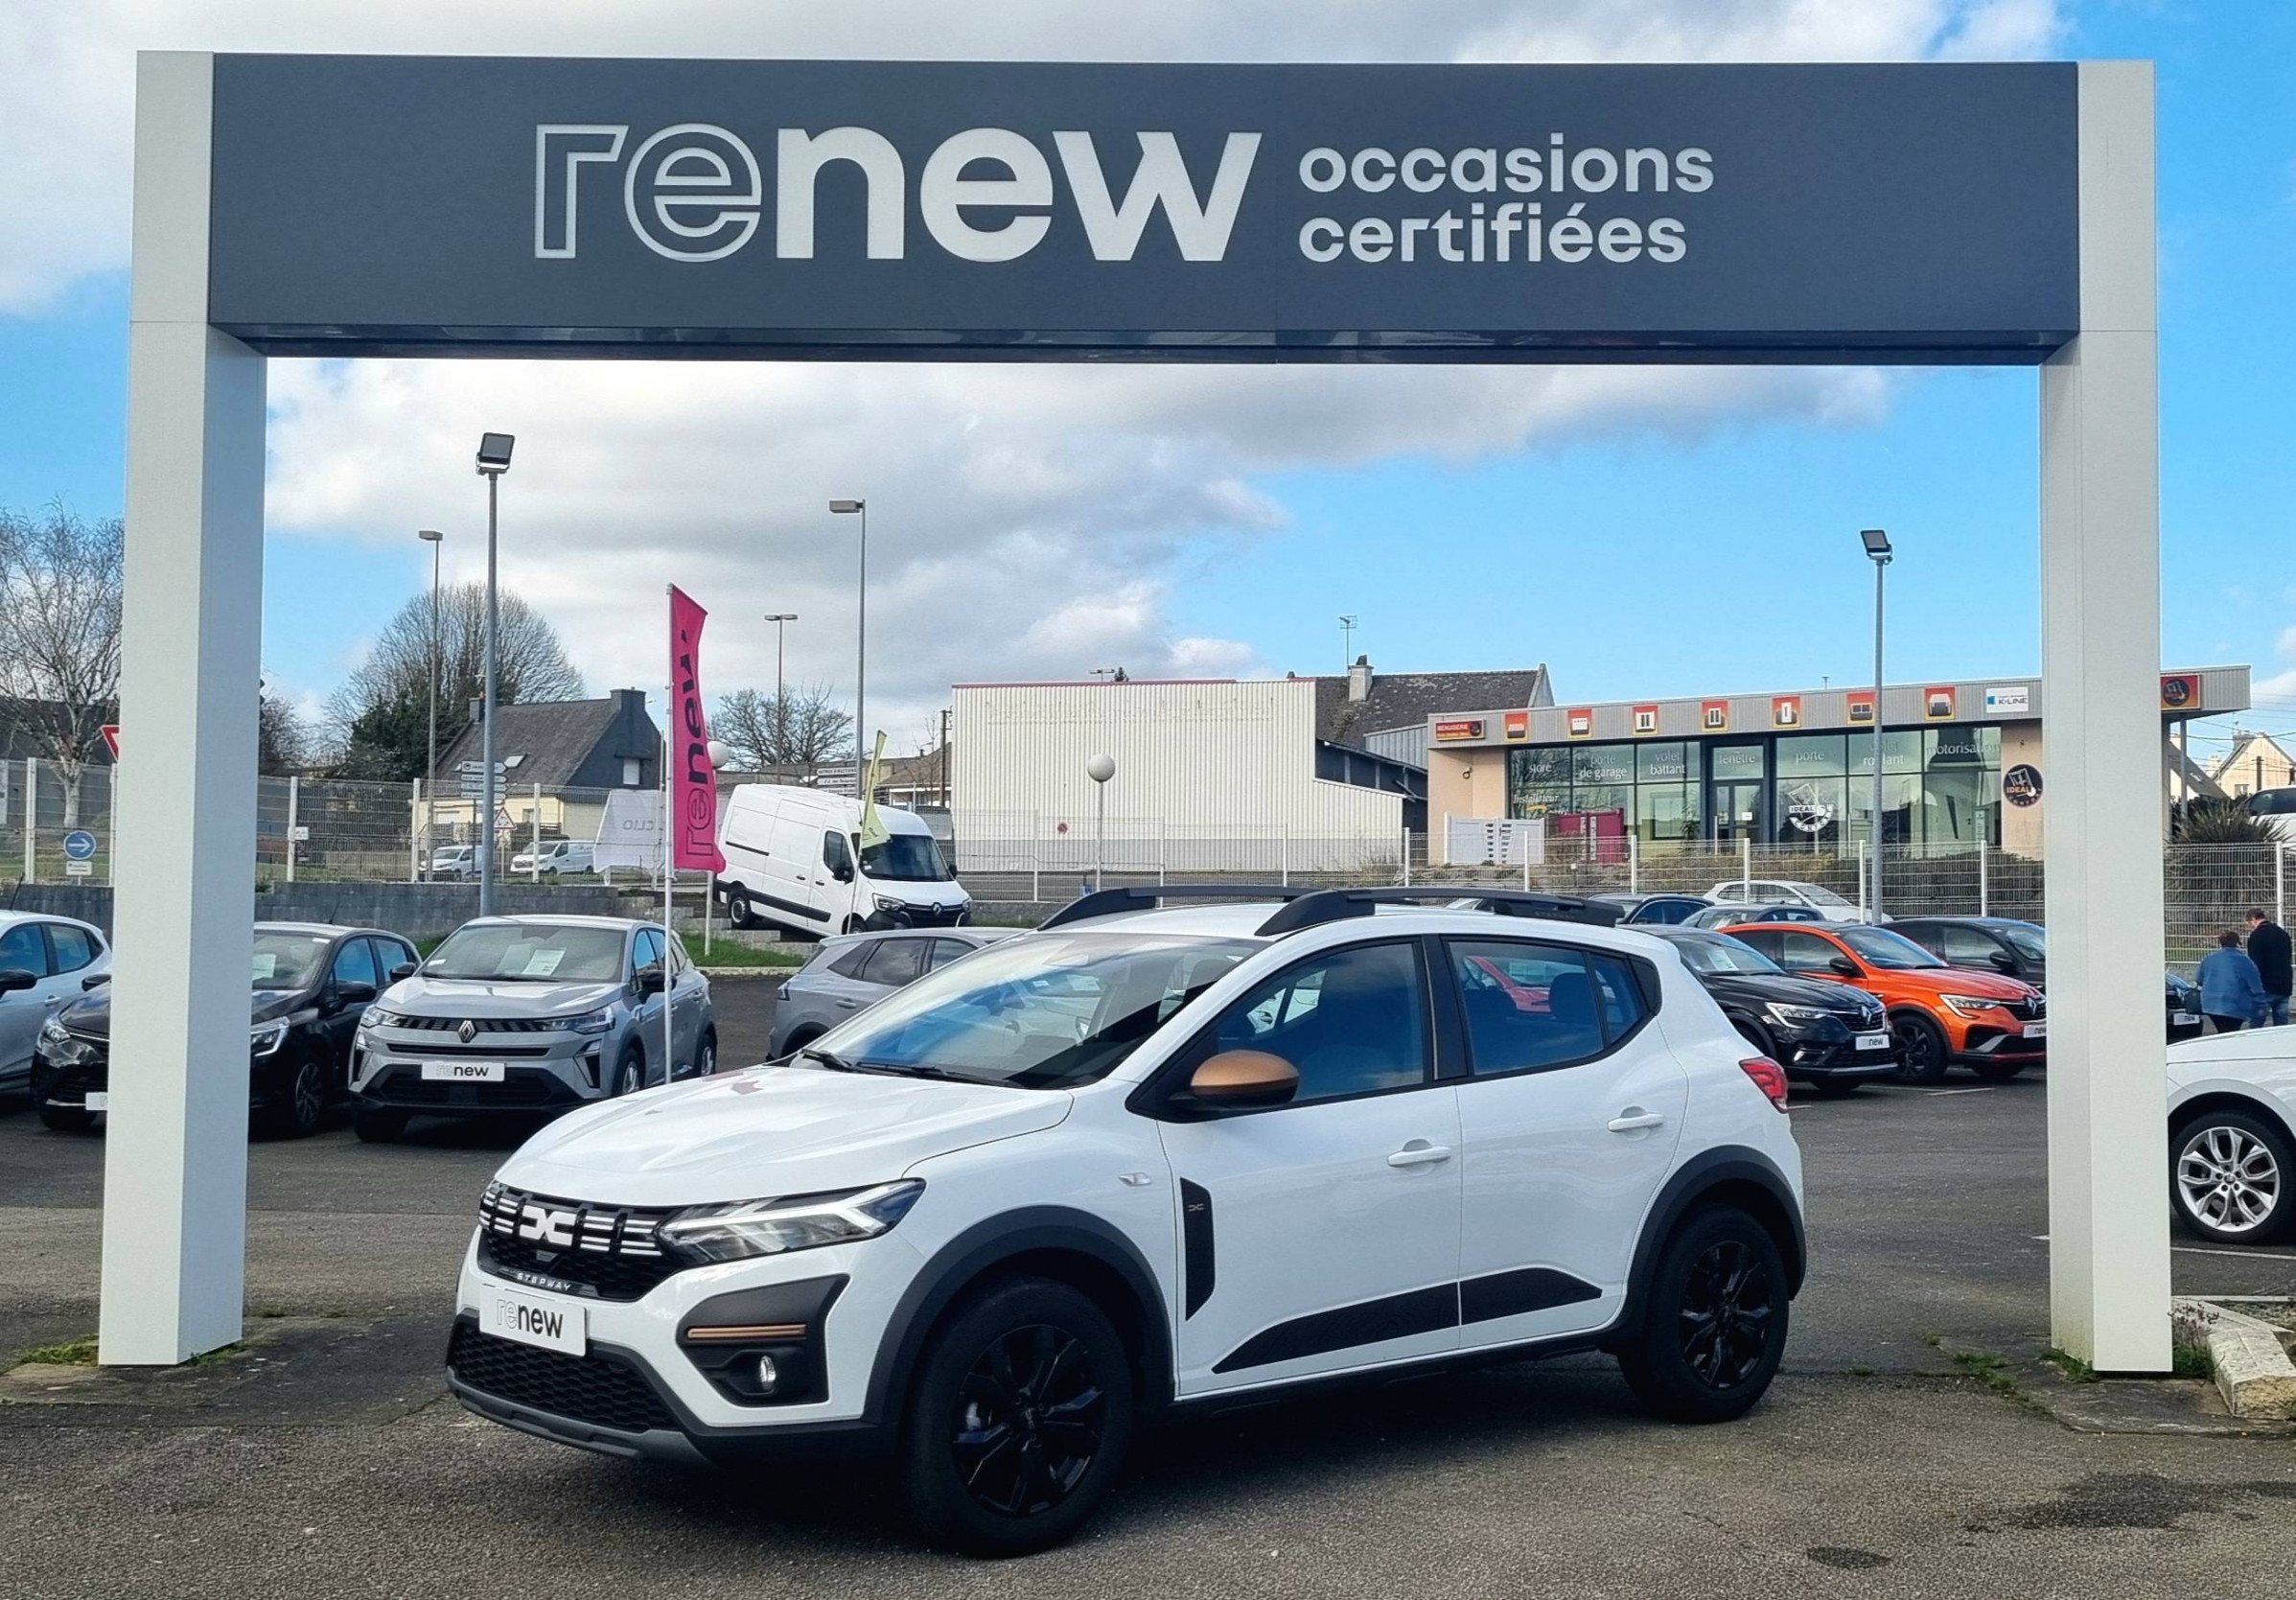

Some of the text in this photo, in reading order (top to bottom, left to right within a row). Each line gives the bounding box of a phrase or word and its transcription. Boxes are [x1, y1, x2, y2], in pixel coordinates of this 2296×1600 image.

[1299, 132, 1714, 195] occasions
[534, 123, 1263, 264] renew
[1298, 199, 1687, 265] certifiées
[1796, 752, 1824, 764] porte
[1864, 754, 1904, 766] rolant
[1579, 767, 1628, 781] de garage
[1650, 763, 1686, 776] battant
[517, 1272, 572, 1291] STEPWAY
[497, 1298, 564, 1339] renew
